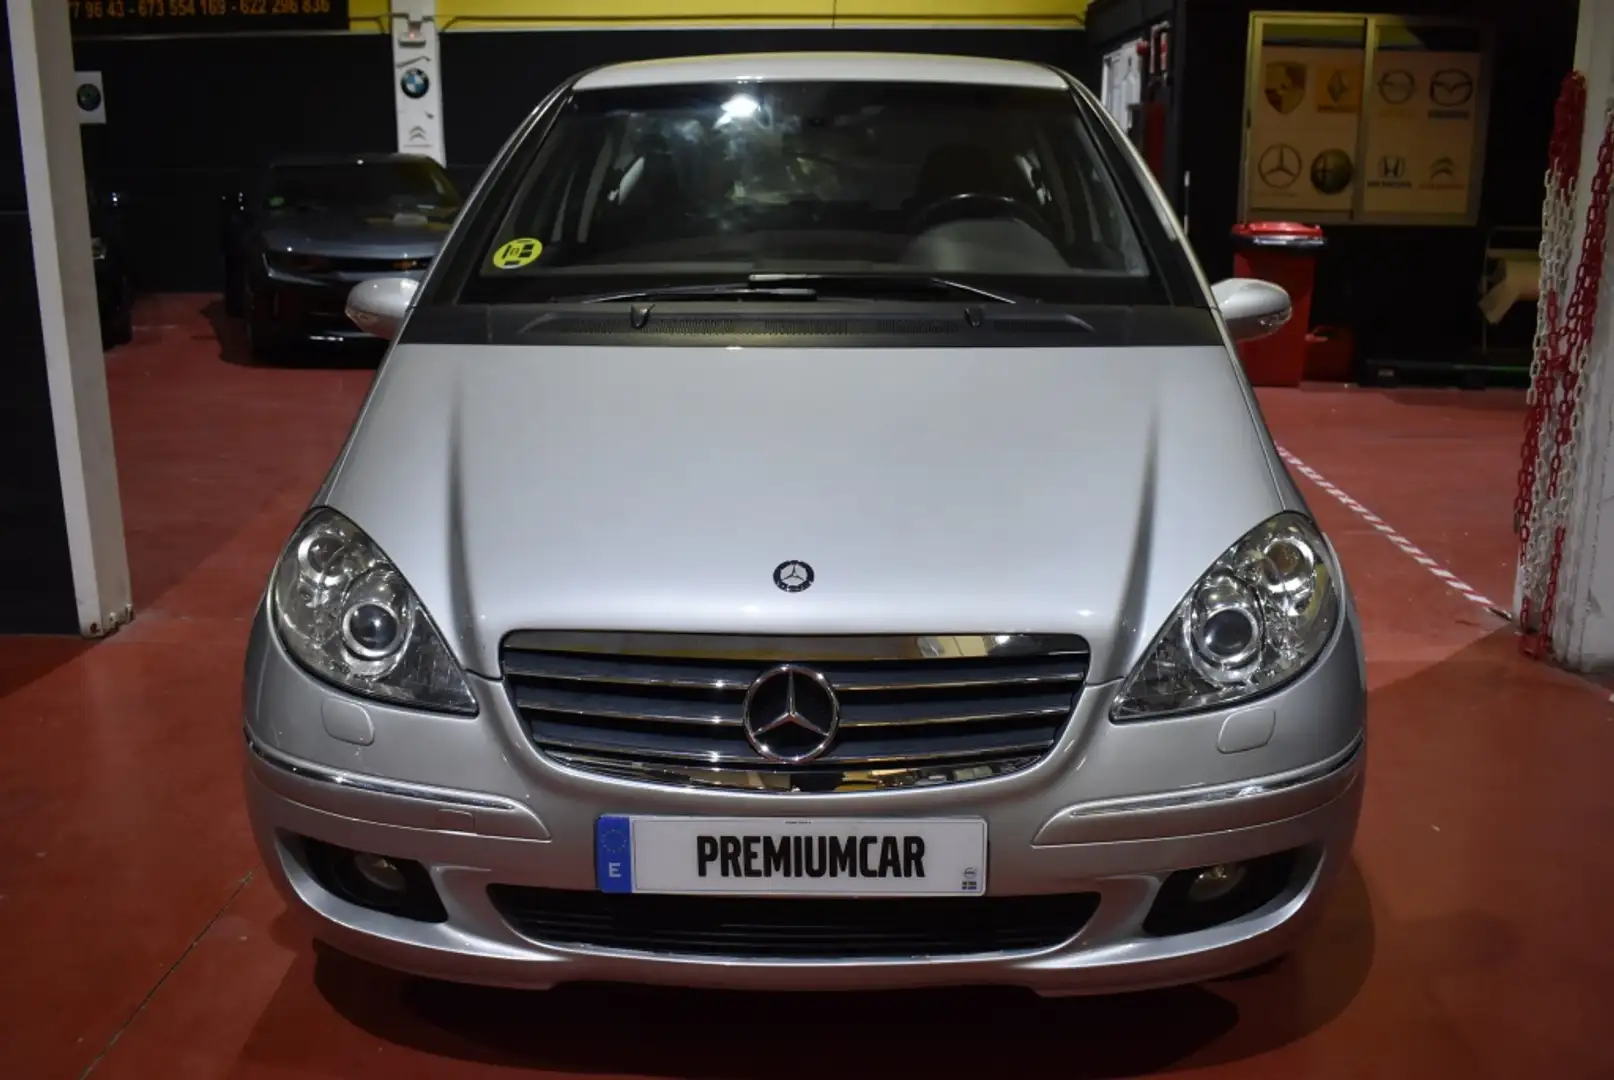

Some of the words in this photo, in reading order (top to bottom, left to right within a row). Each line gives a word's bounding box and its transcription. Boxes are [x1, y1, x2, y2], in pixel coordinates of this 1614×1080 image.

[84, 0, 102, 18] 96
[107, 0, 125, 17] 43
[138, 0, 164, 17] 673
[169, 0, 195, 16] 554
[697, 836, 925, 877] PREMIUMCAR
[608, 862, 622, 878] E
